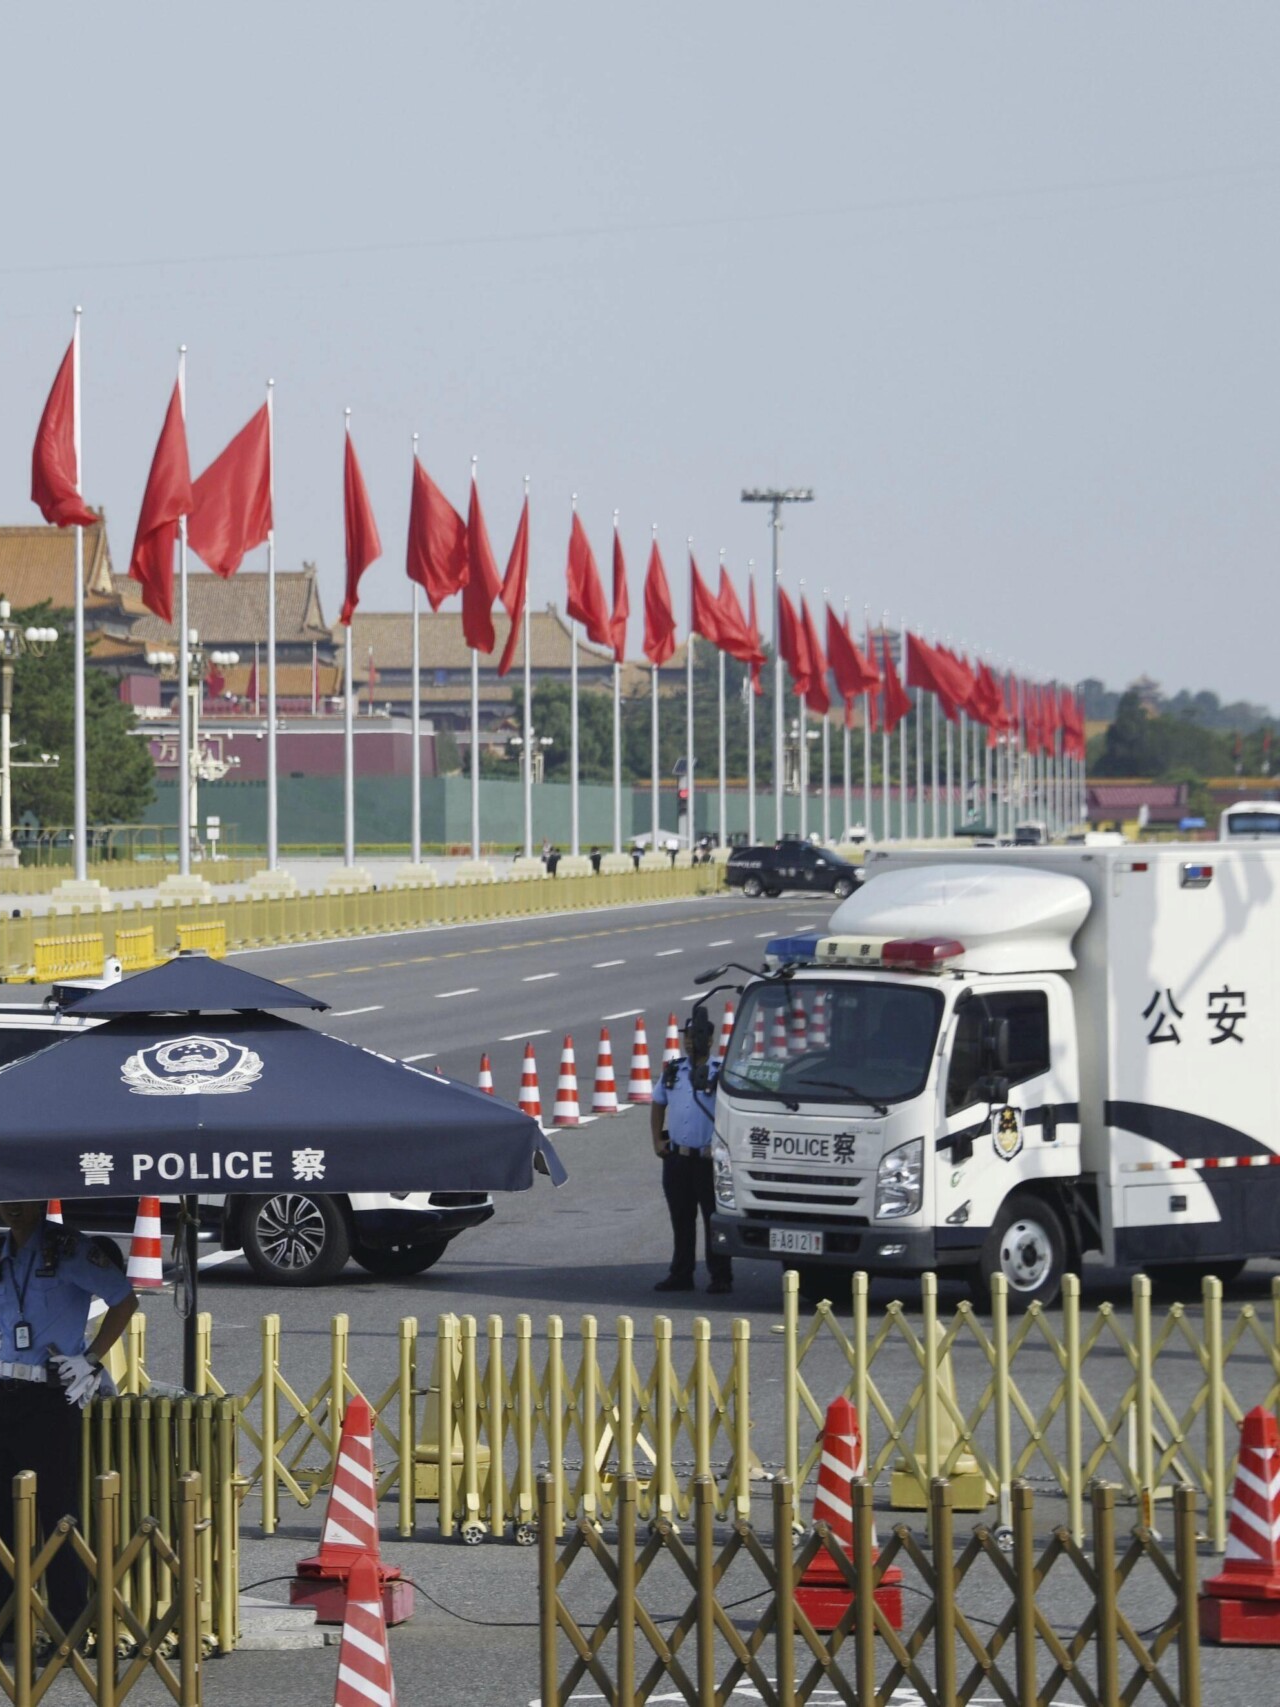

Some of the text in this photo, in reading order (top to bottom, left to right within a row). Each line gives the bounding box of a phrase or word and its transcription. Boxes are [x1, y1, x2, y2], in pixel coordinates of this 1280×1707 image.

[1141, 984, 1247, 1046] 公安
[749, 1126, 856, 1165] 警 POLICE 察
[79, 1147, 327, 1187] 警 POLICE 察
